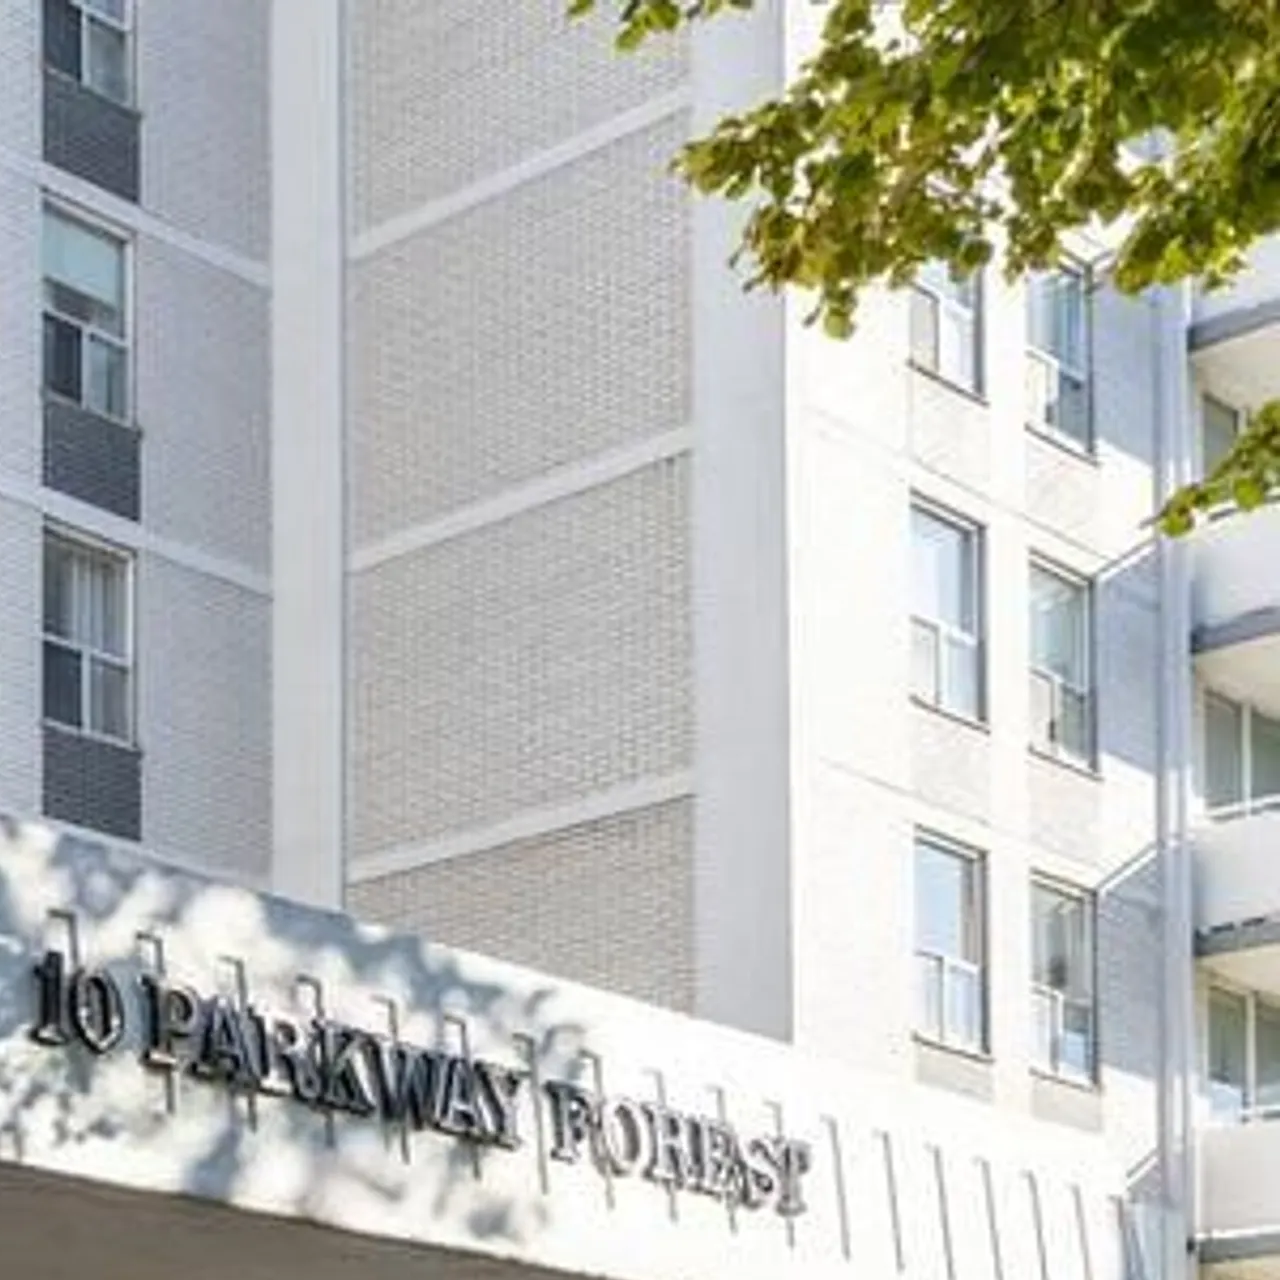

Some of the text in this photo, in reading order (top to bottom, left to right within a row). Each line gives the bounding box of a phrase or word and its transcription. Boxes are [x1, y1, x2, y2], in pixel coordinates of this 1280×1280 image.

[28, 950, 811, 1216] 10 PARKWAY FOREST
